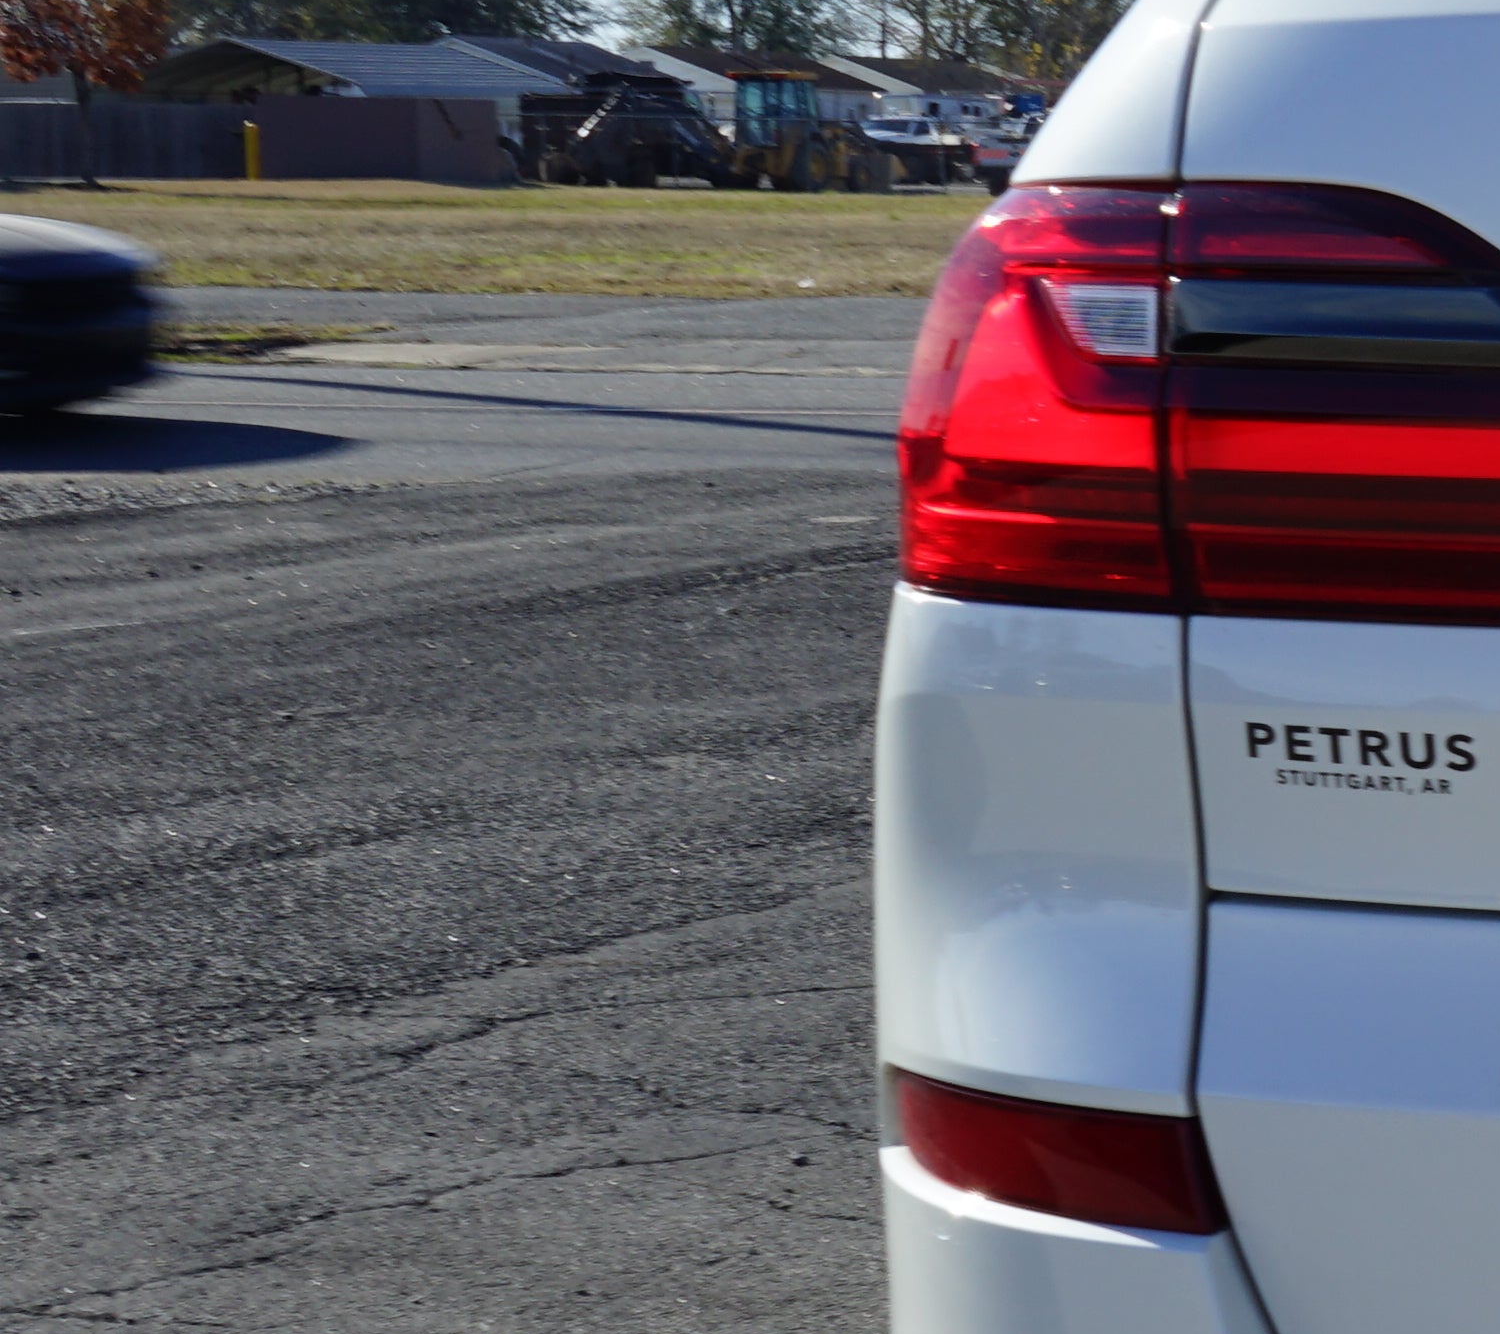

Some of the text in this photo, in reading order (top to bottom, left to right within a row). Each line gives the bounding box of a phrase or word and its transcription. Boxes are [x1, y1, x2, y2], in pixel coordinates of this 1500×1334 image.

[1245, 721, 1476, 771] PETRUS
[1275, 768, 1453, 795] STUTTGART, AR
